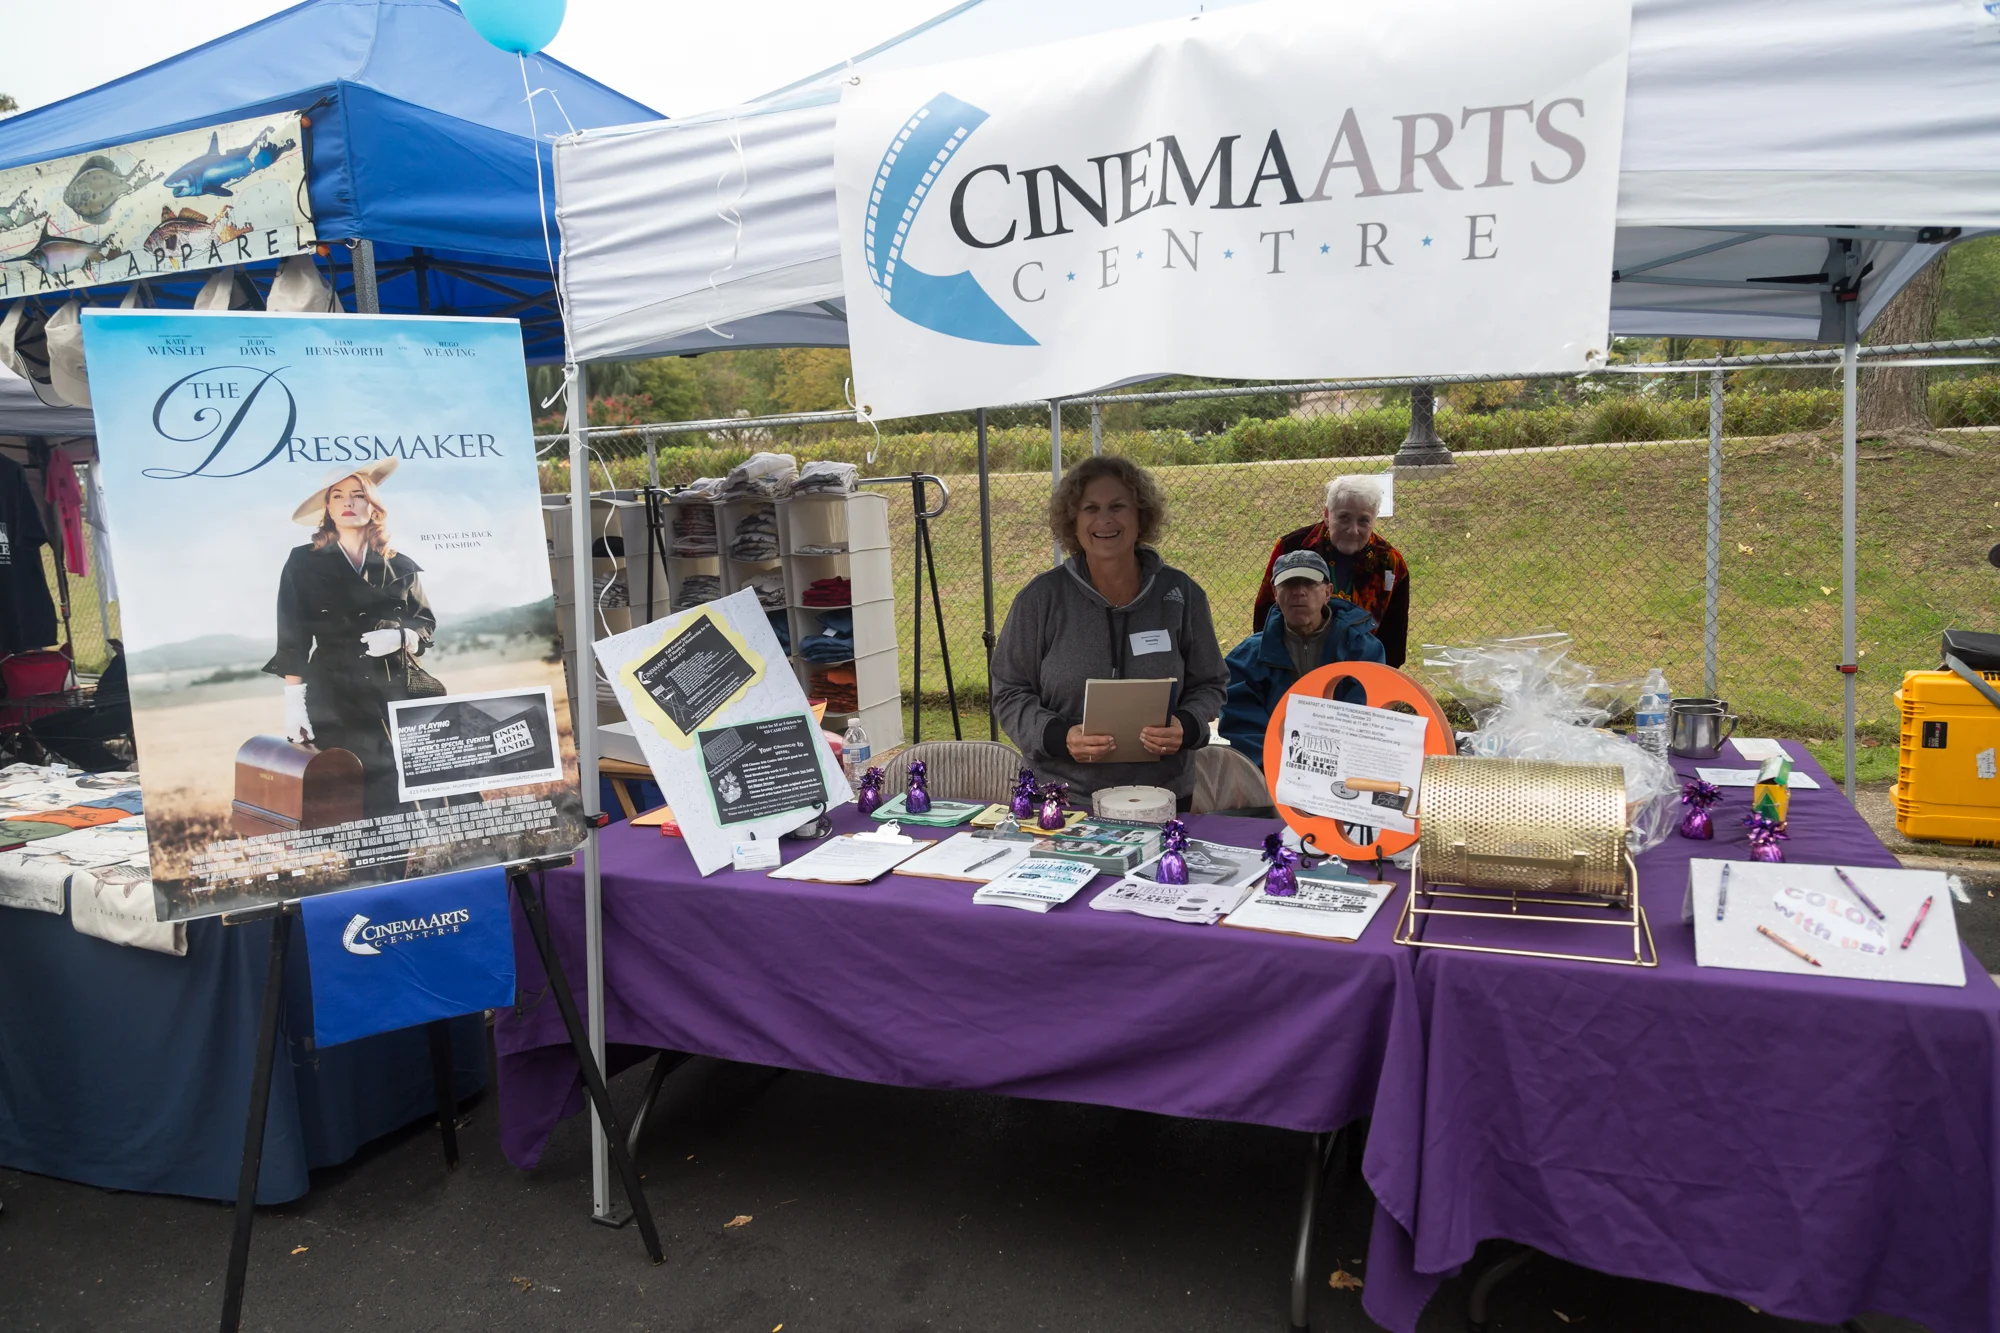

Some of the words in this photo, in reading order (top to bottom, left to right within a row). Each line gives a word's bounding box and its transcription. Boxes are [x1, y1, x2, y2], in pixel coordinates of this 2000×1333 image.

[127, 225, 308, 277] APPAREL
[147, 346, 207, 356] WINSLET
[240, 346, 276, 356] DAVIS
[305, 347, 384, 356] HEMSWORTH
[423, 348, 476, 357] WEAVING
[186, 382, 240, 399] THE
[142, 366, 505, 480] DRESSMAKER
[420, 533, 459, 541] REVENGE
[446, 541, 481, 549] FASHION
[1297, 699, 1319, 707] BREAKFAST
[1344, 707, 1371, 716] FUNDRAISING
[1393, 716, 1414, 725] Screening
[397, 725, 416, 734] NOW
[417, 719, 450, 731] PLAYING
[495, 723, 526, 739] CINEMA
[417, 743, 439, 752] WEEK'S
[440, 739, 464, 748] SPECIAL
[498, 738, 533, 754] CENTRE
[501, 732, 524, 745] ARTS
[758, 746, 772, 754] Your
[772, 741, 795, 750] Chance
[1285, 760, 1306, 770] Cinema
[1307, 765, 1337, 777] Campaign
[452, 780, 480, 790] Huntington
[487, 770, 552, 786] www.CinemaArtsCentre.org
[1784, 886, 1885, 938] COLOR
[1773, 901, 1832, 941] with
